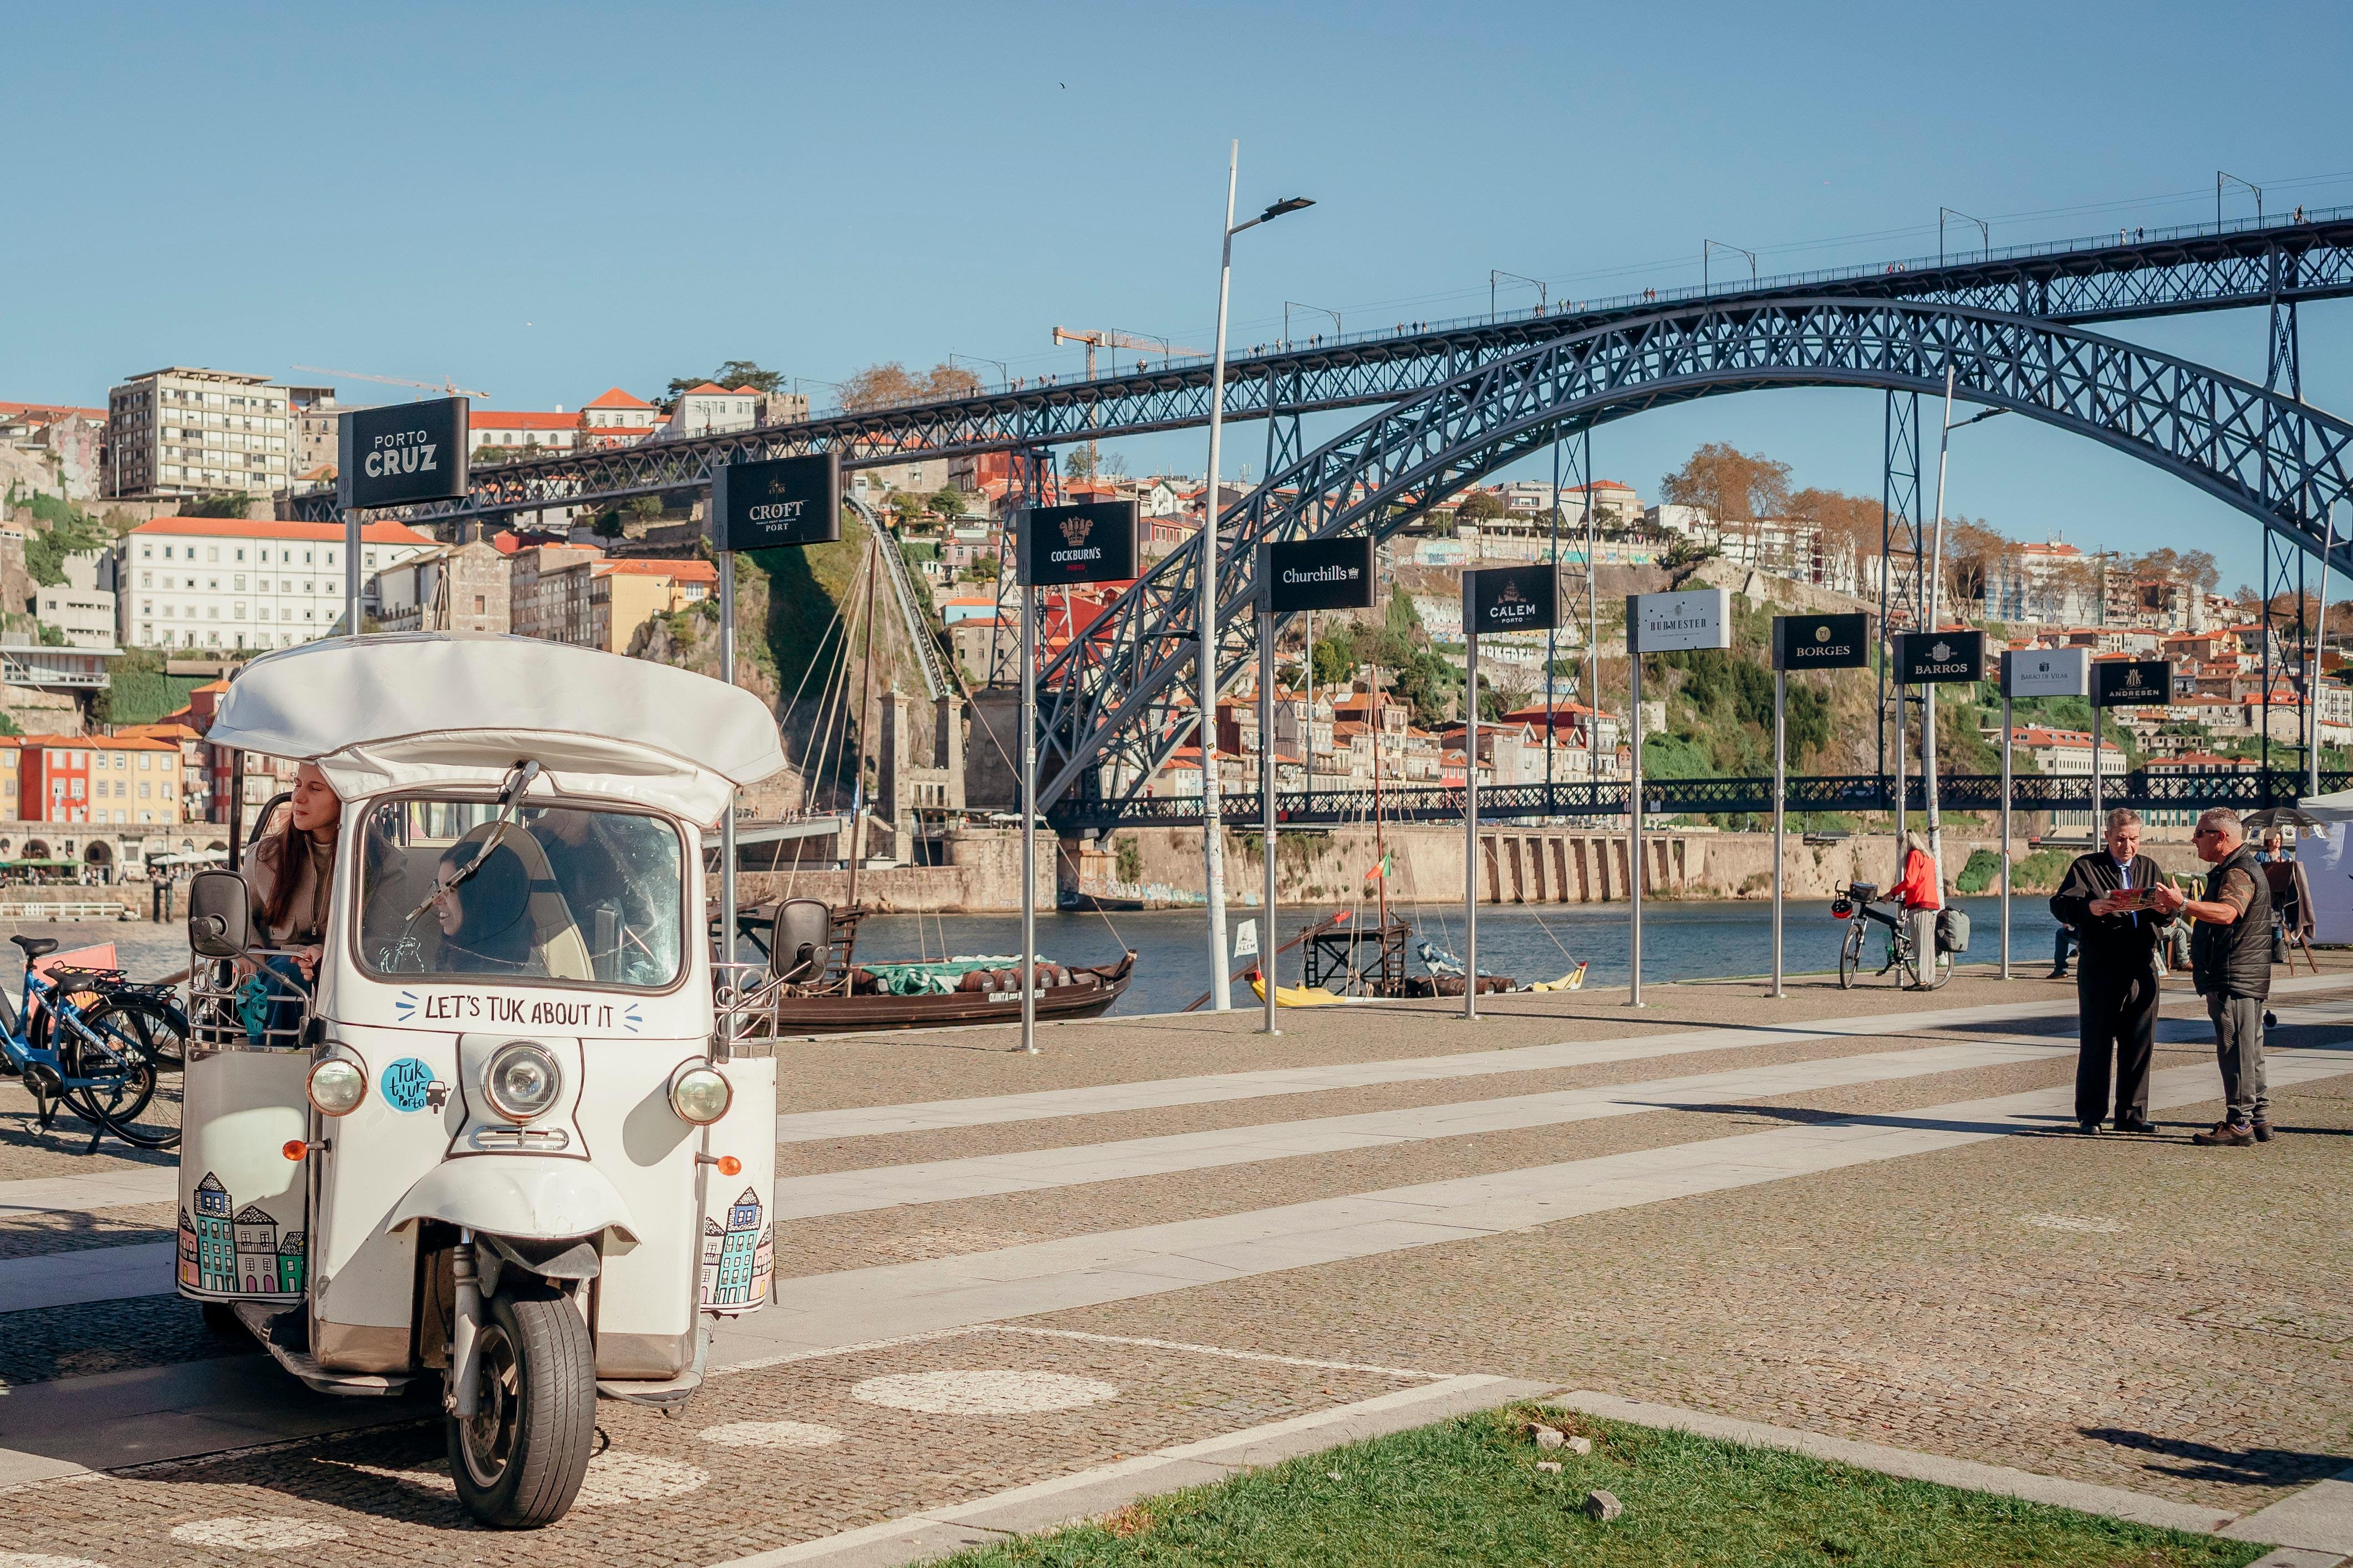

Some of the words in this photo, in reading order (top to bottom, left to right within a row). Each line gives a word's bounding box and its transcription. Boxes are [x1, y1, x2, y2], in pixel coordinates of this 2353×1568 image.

[375, 430, 427, 449] PORTO
[365, 444, 437, 477] CRUZ
[749, 502, 803, 520] CROFT
[766, 523, 788, 532] PORT
[1051, 546, 1101, 562] COCKBURN'S
[1283, 565, 1347, 583] Churchill's
[1490, 604, 1535, 617] CÁLEM
[1651, 619, 1707, 631] BURMESTER
[1796, 646, 1850, 657] BORGES
[1915, 663, 1968, 675] BARROS
[989, 992, 1009, 1003] QUINTA
[425, 995, 480, 1019] LET'S
[487, 996, 526, 1024] TUK
[531, 1002, 592, 1025] ABOUT
[598, 1004, 614, 1028] IT
[82, 1029, 95, 1043] AND
[389, 1058, 427, 1082] Tuk
[398, 1095, 425, 1109] Porto
